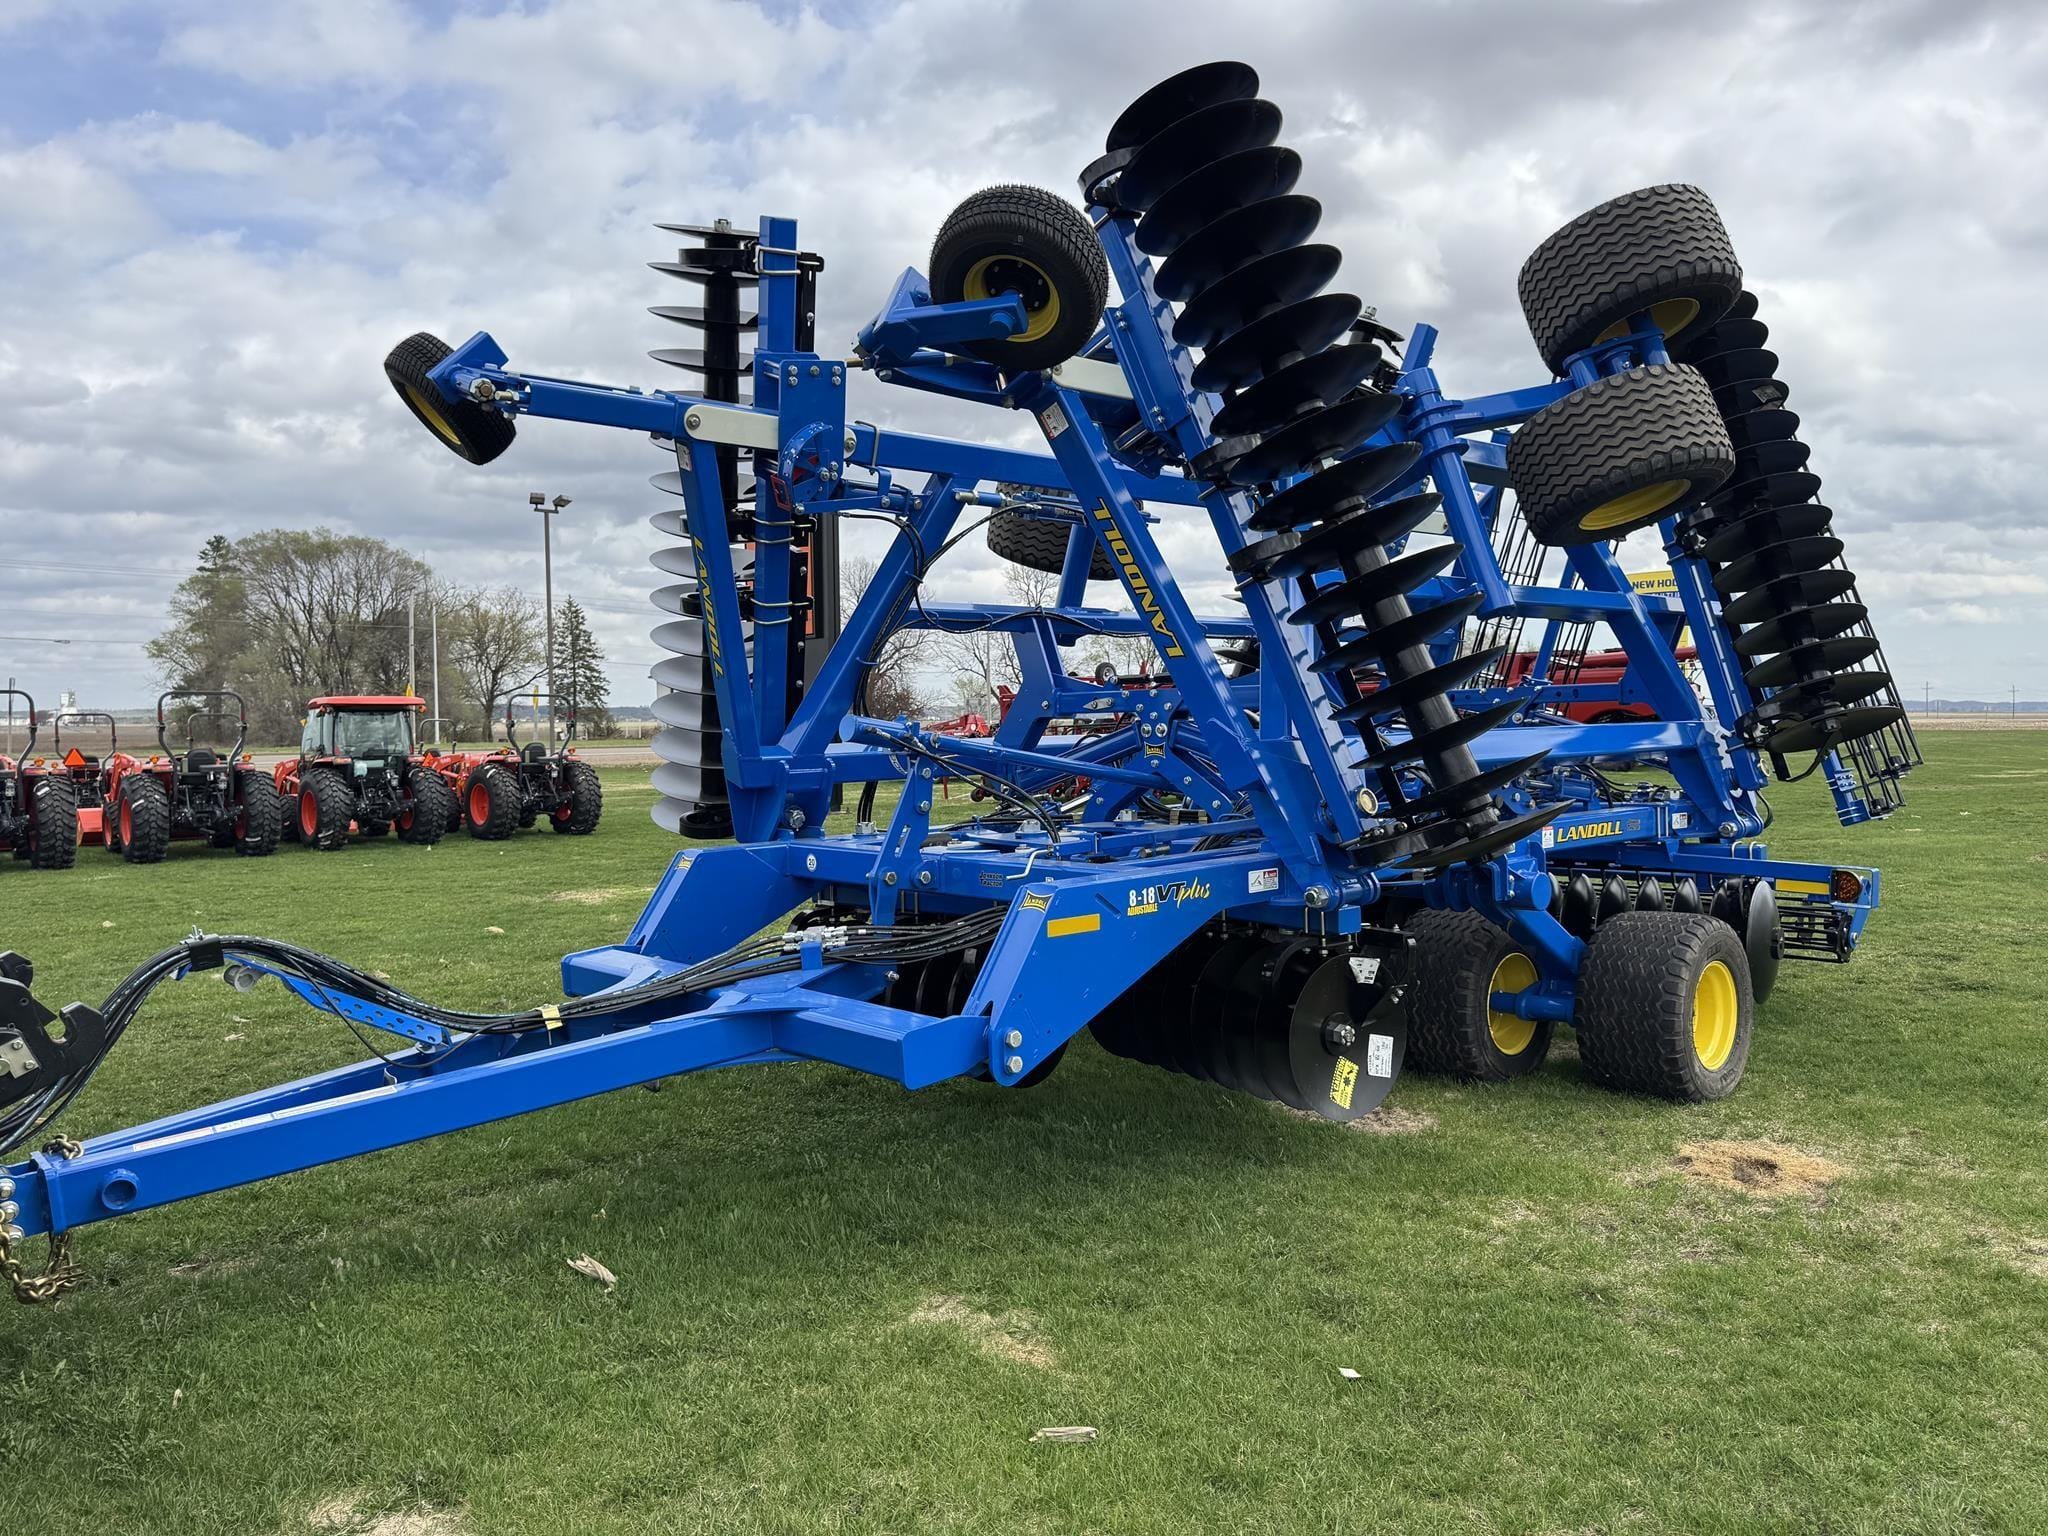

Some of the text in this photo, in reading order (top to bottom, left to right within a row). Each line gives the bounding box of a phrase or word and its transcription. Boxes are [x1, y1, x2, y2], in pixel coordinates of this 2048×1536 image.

[1093, 497, 1185, 658] LANDOLL
[1632, 580, 1655, 589] NEW
[693, 535, 724, 678] LANDOLL
[1556, 820, 1624, 843] LANDOLL
[1129, 886, 1155, 907] 8-18
